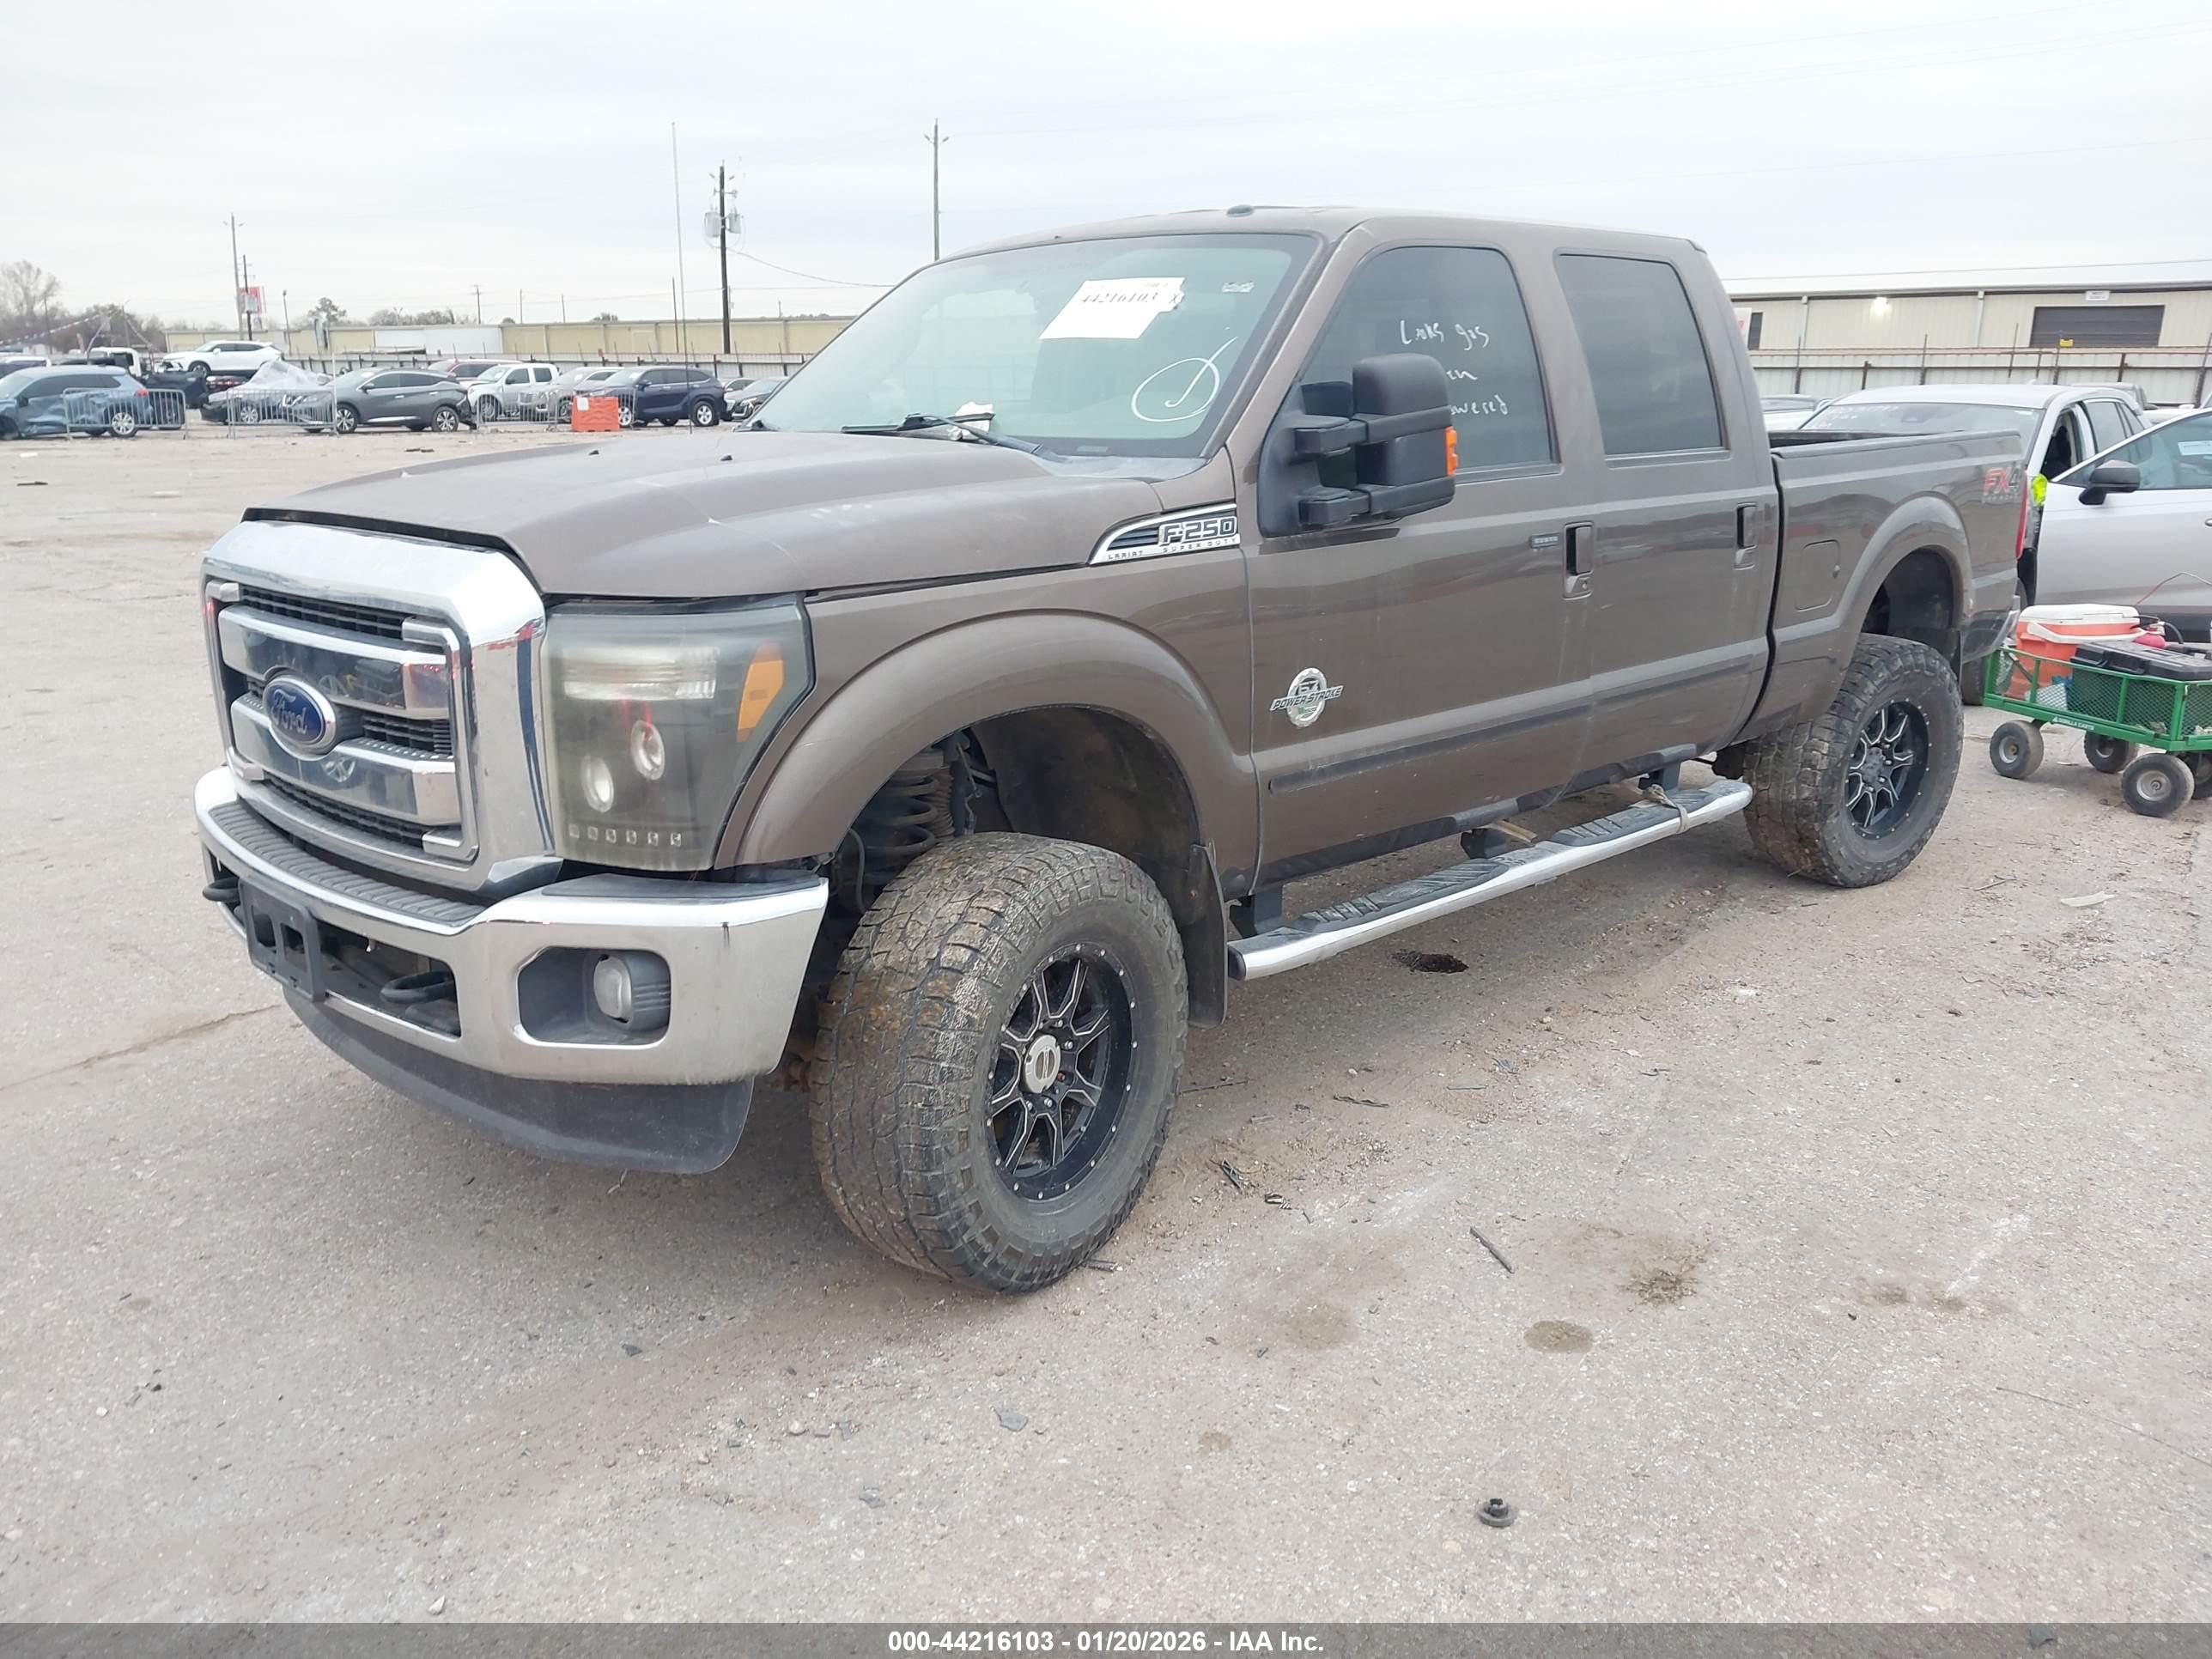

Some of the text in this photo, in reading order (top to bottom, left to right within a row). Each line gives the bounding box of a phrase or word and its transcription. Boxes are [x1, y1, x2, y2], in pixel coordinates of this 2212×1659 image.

[1162, 517, 1237, 544] F-250
[1108, 550, 1144, 560] LARIAT
[1163, 538, 1237, 552] SUPER DUTY
[1273, 686, 1342, 710] POWER STROKE
[271, 689, 307, 734] Ford
